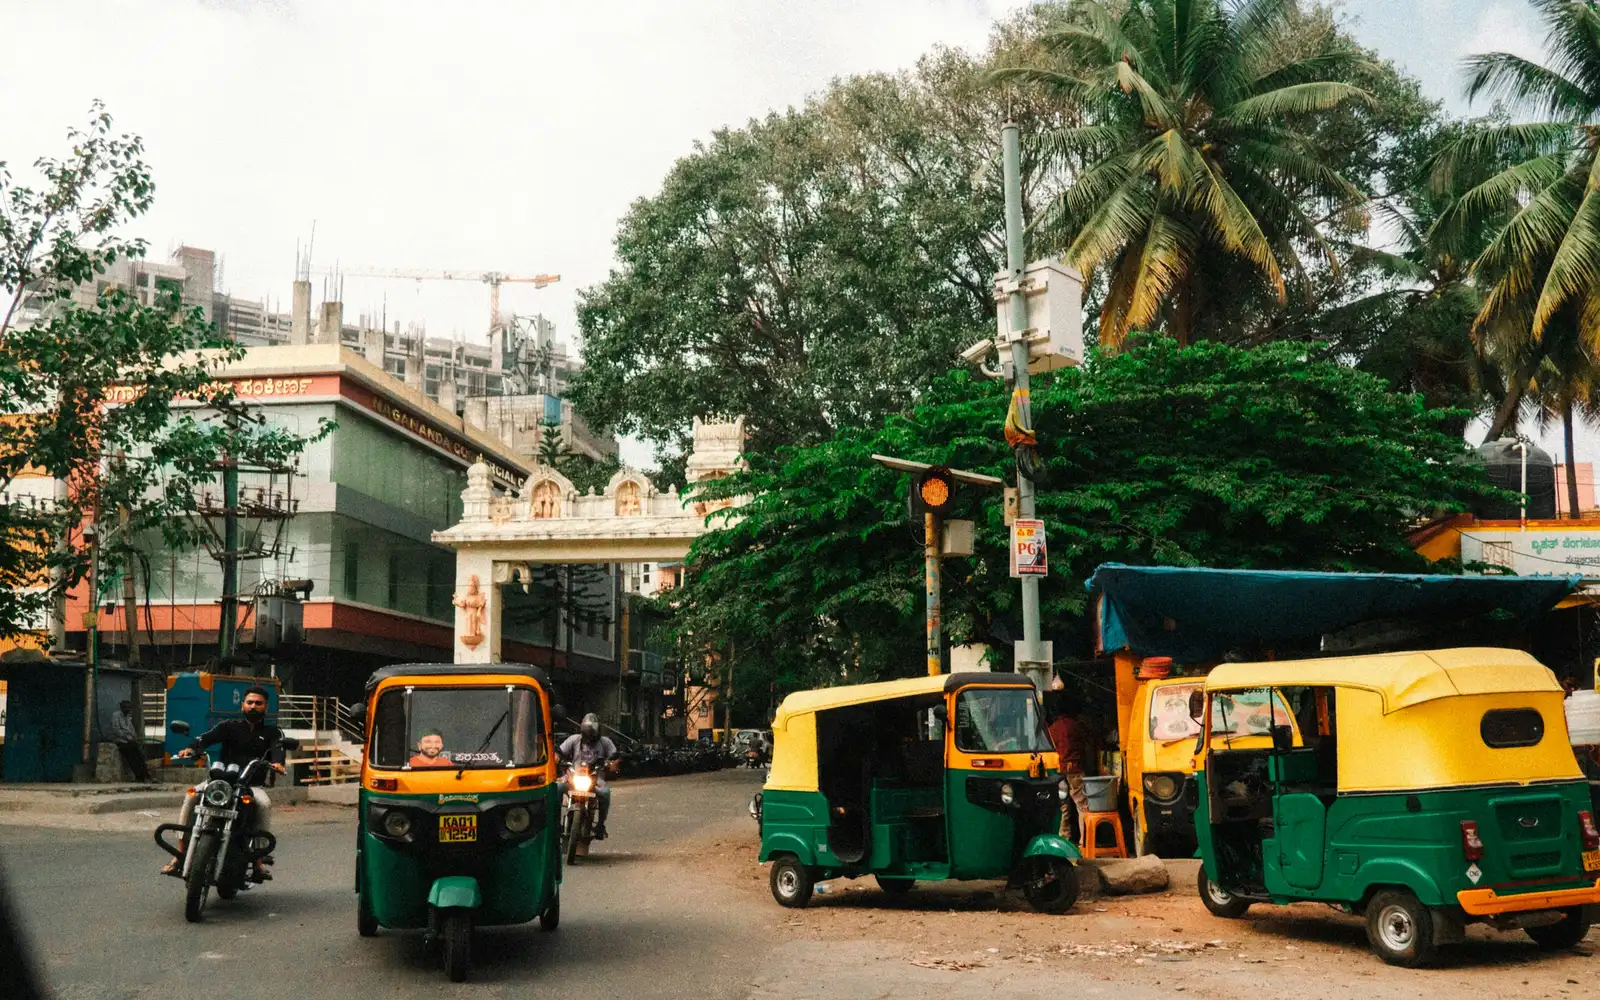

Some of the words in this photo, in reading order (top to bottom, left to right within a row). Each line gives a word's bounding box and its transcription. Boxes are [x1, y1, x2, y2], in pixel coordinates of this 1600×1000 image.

[371, 395, 450, 450] NAGANANDA
[1017, 542, 1036, 556] PG
[443, 816, 473, 827] KA01
